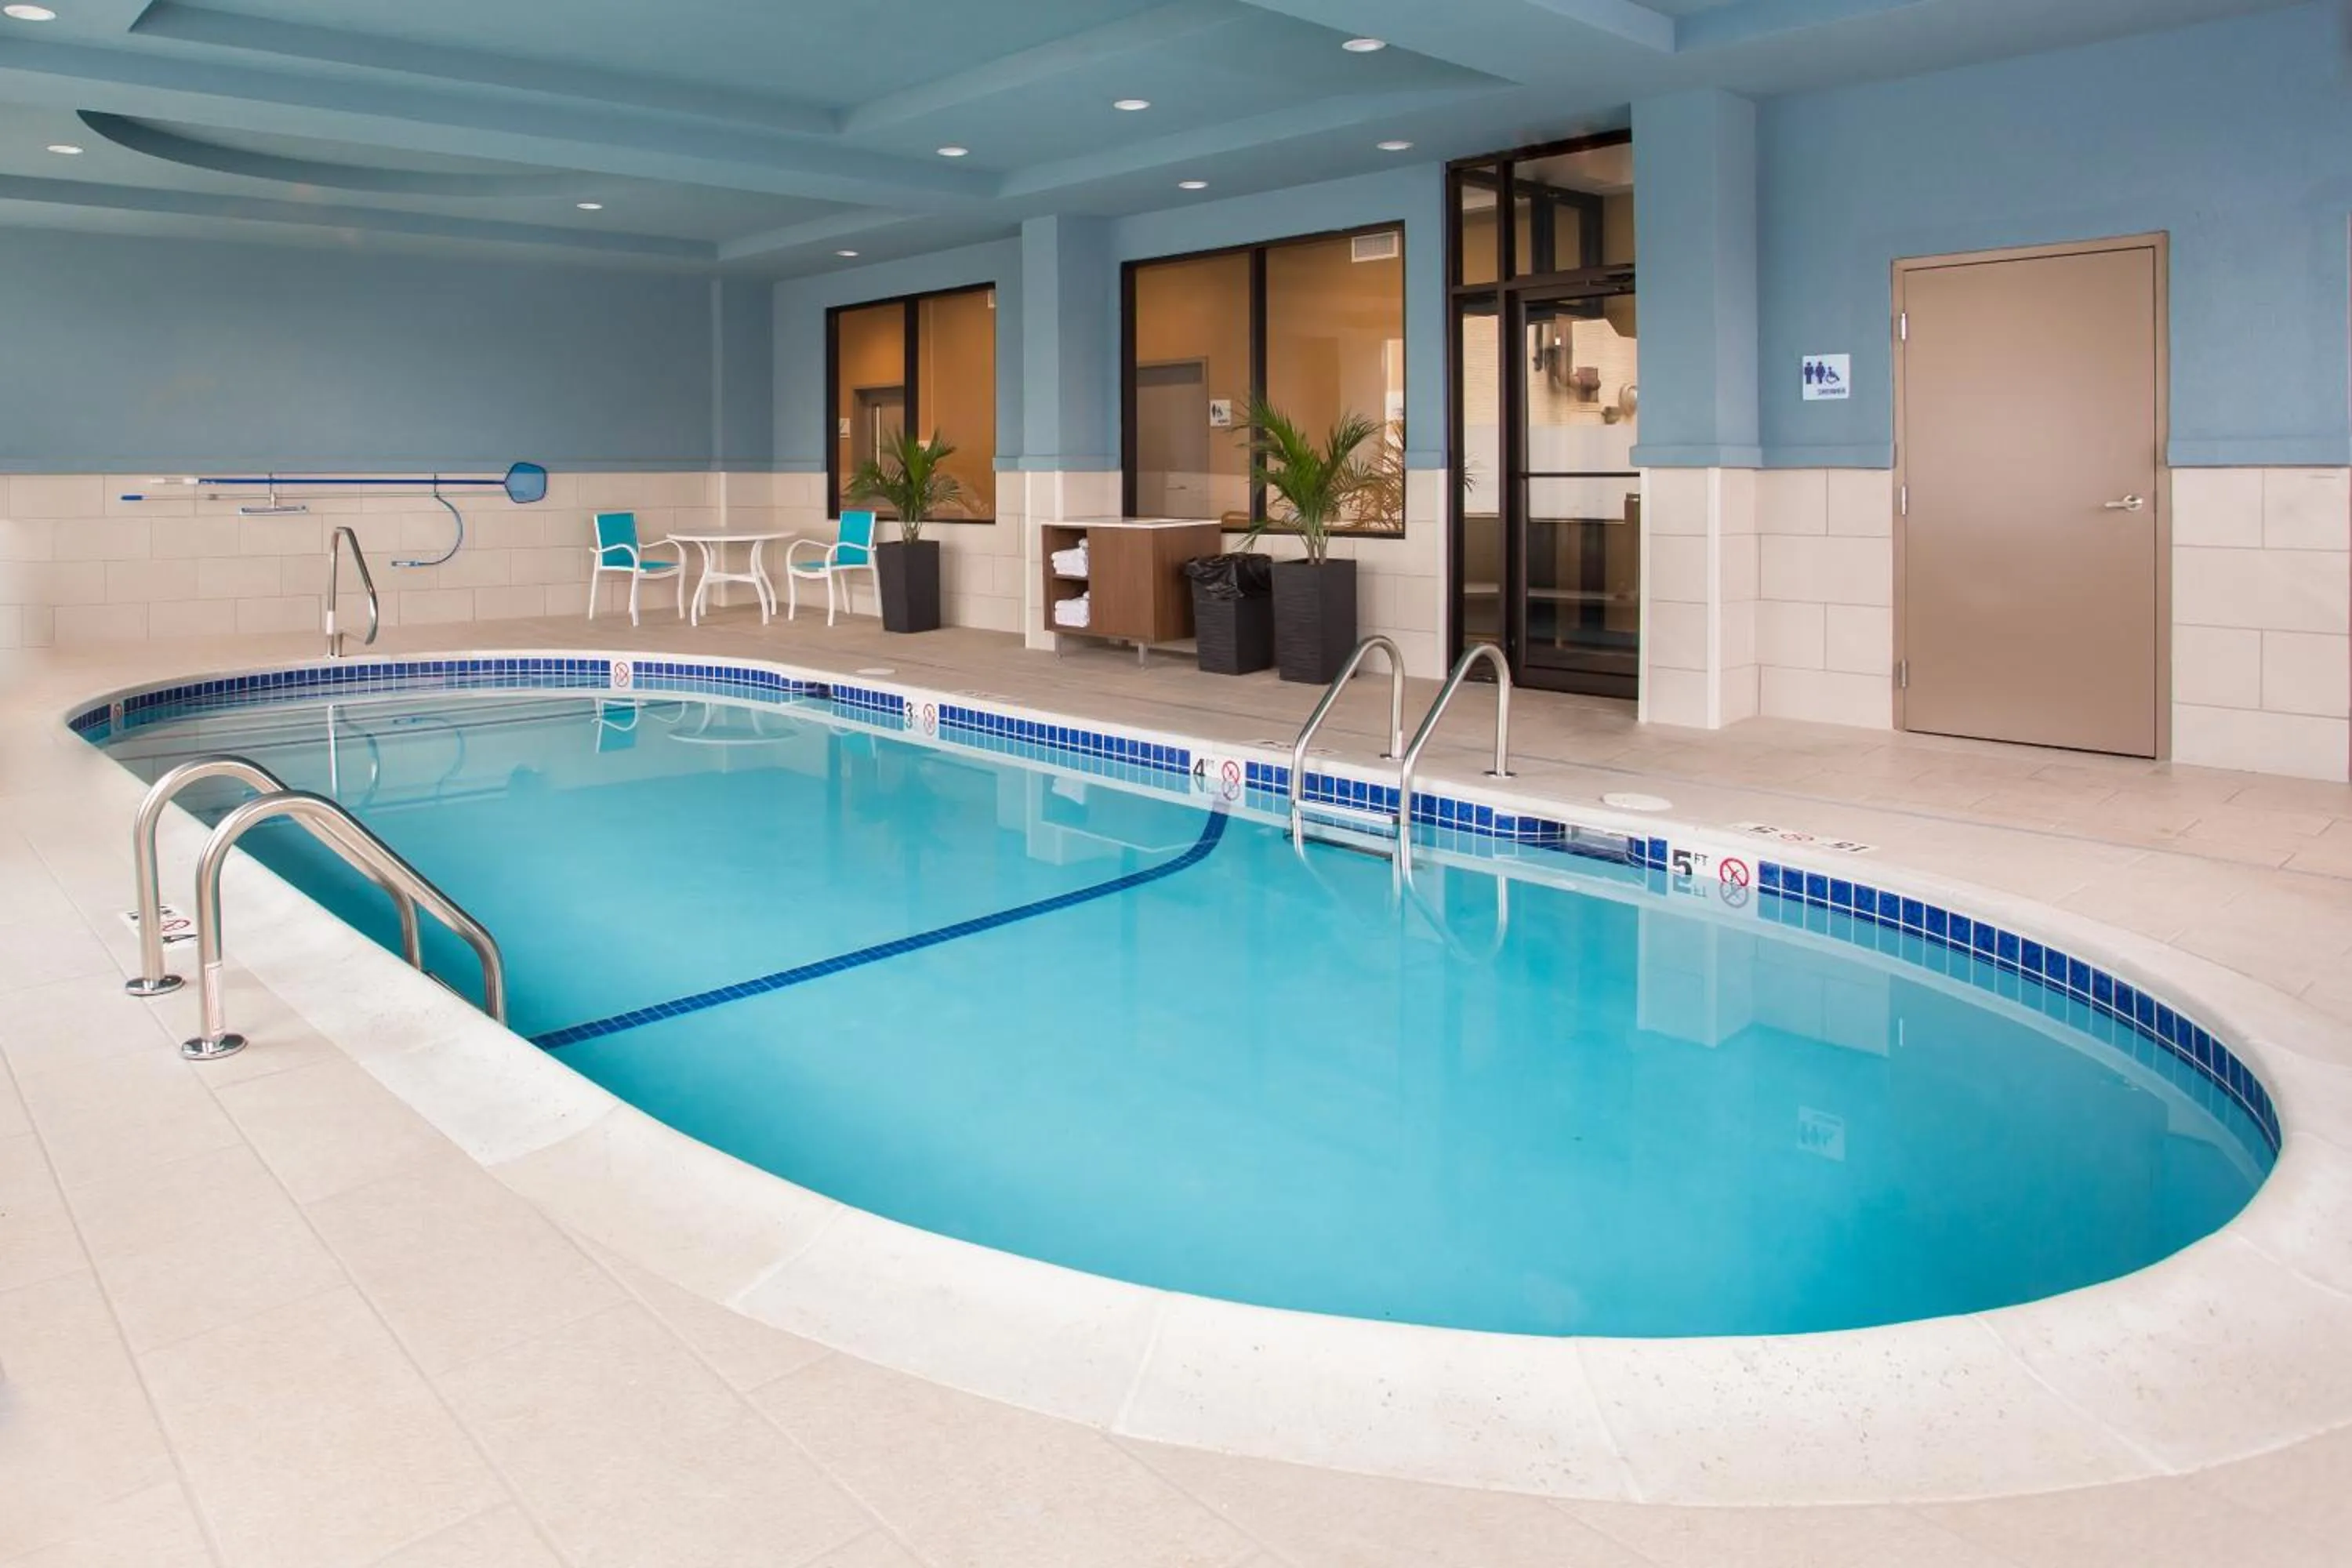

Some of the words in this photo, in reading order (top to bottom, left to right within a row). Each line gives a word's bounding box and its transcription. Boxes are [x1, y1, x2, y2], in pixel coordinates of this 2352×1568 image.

[1192, 758, 1205, 776] 4
[1672, 849, 1693, 876] 5
[1694, 852, 1709, 866] FT
